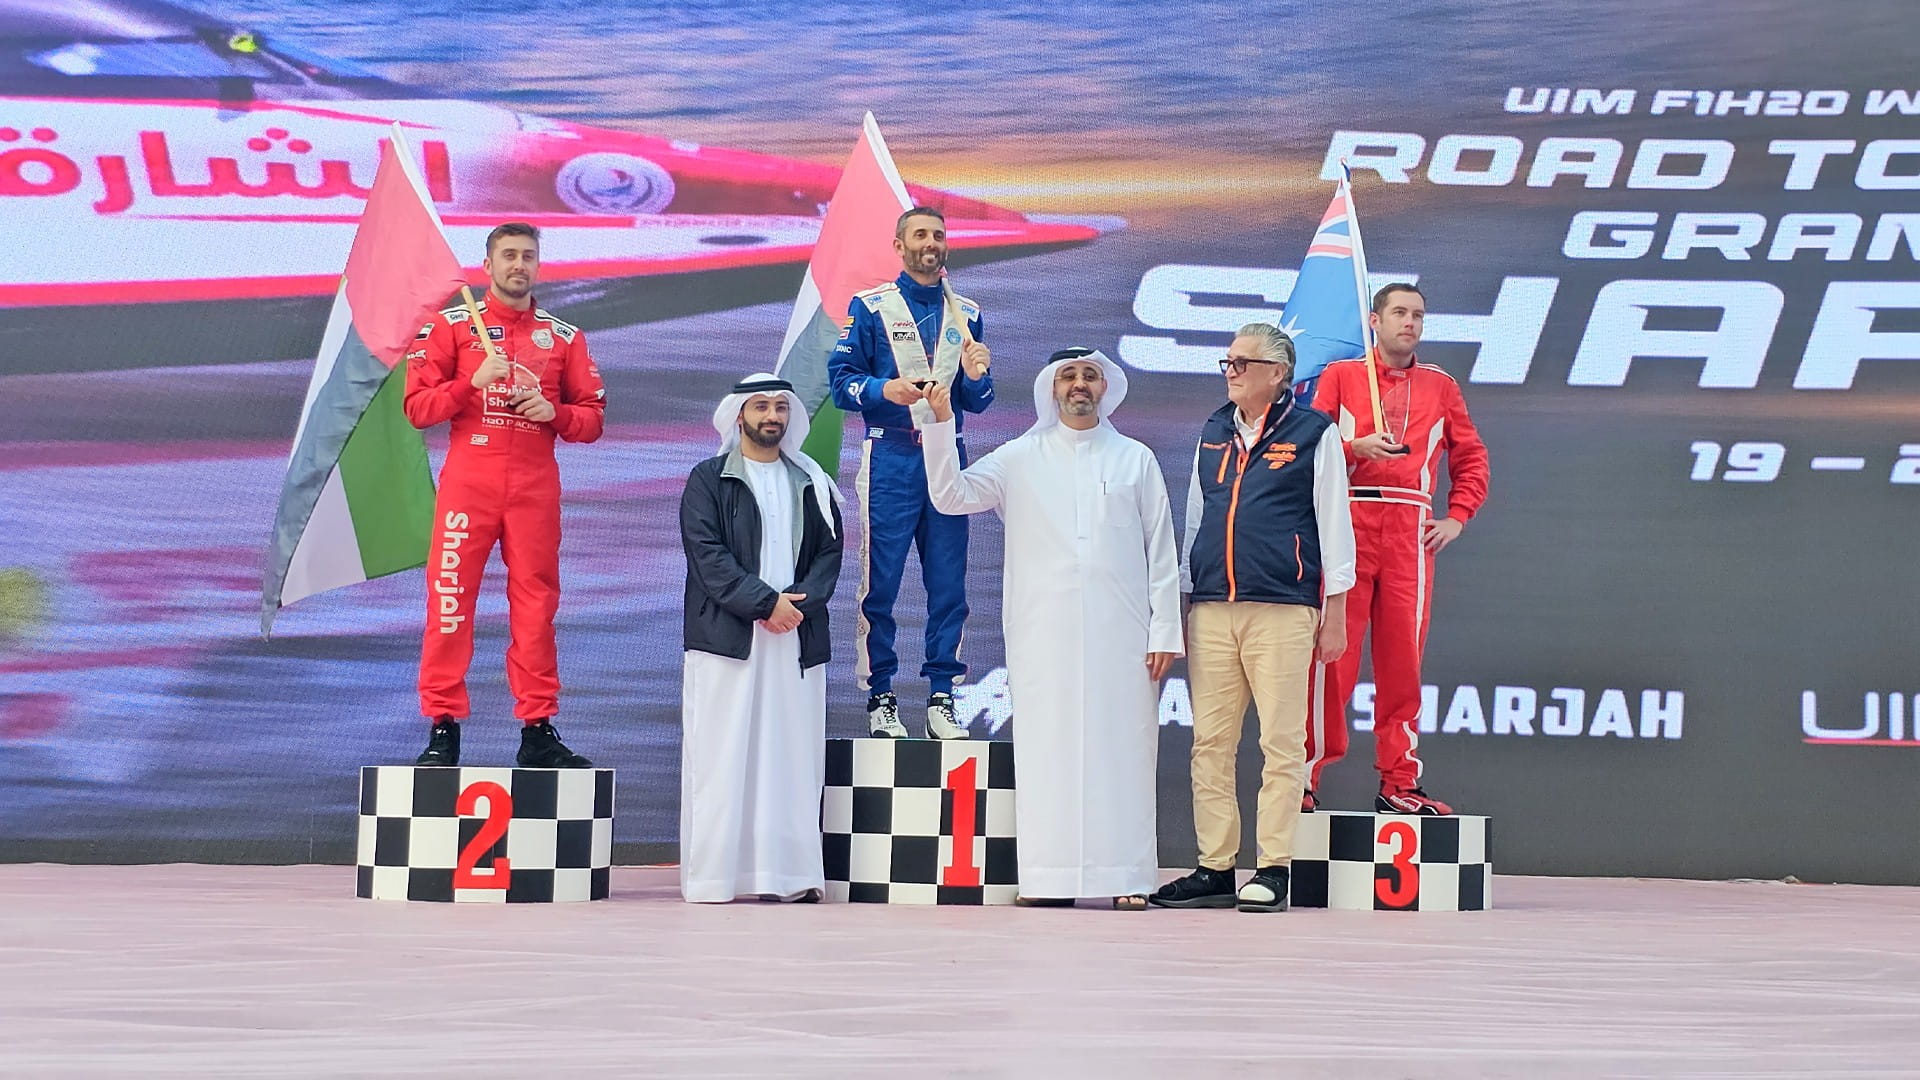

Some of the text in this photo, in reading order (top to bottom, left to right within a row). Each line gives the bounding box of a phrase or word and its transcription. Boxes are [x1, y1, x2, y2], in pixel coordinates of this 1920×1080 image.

[1503, 87, 1637, 115] UIM
[1319, 130, 1920, 190] ROAD TO
[1690, 441, 1786, 481] 19
[434, 510, 469, 634] Sharjah
[1802, 690, 1920, 741] UI
[453, 781, 514, 890] 2
[943, 756, 980, 887] 1
[1374, 821, 1420, 908] 3
